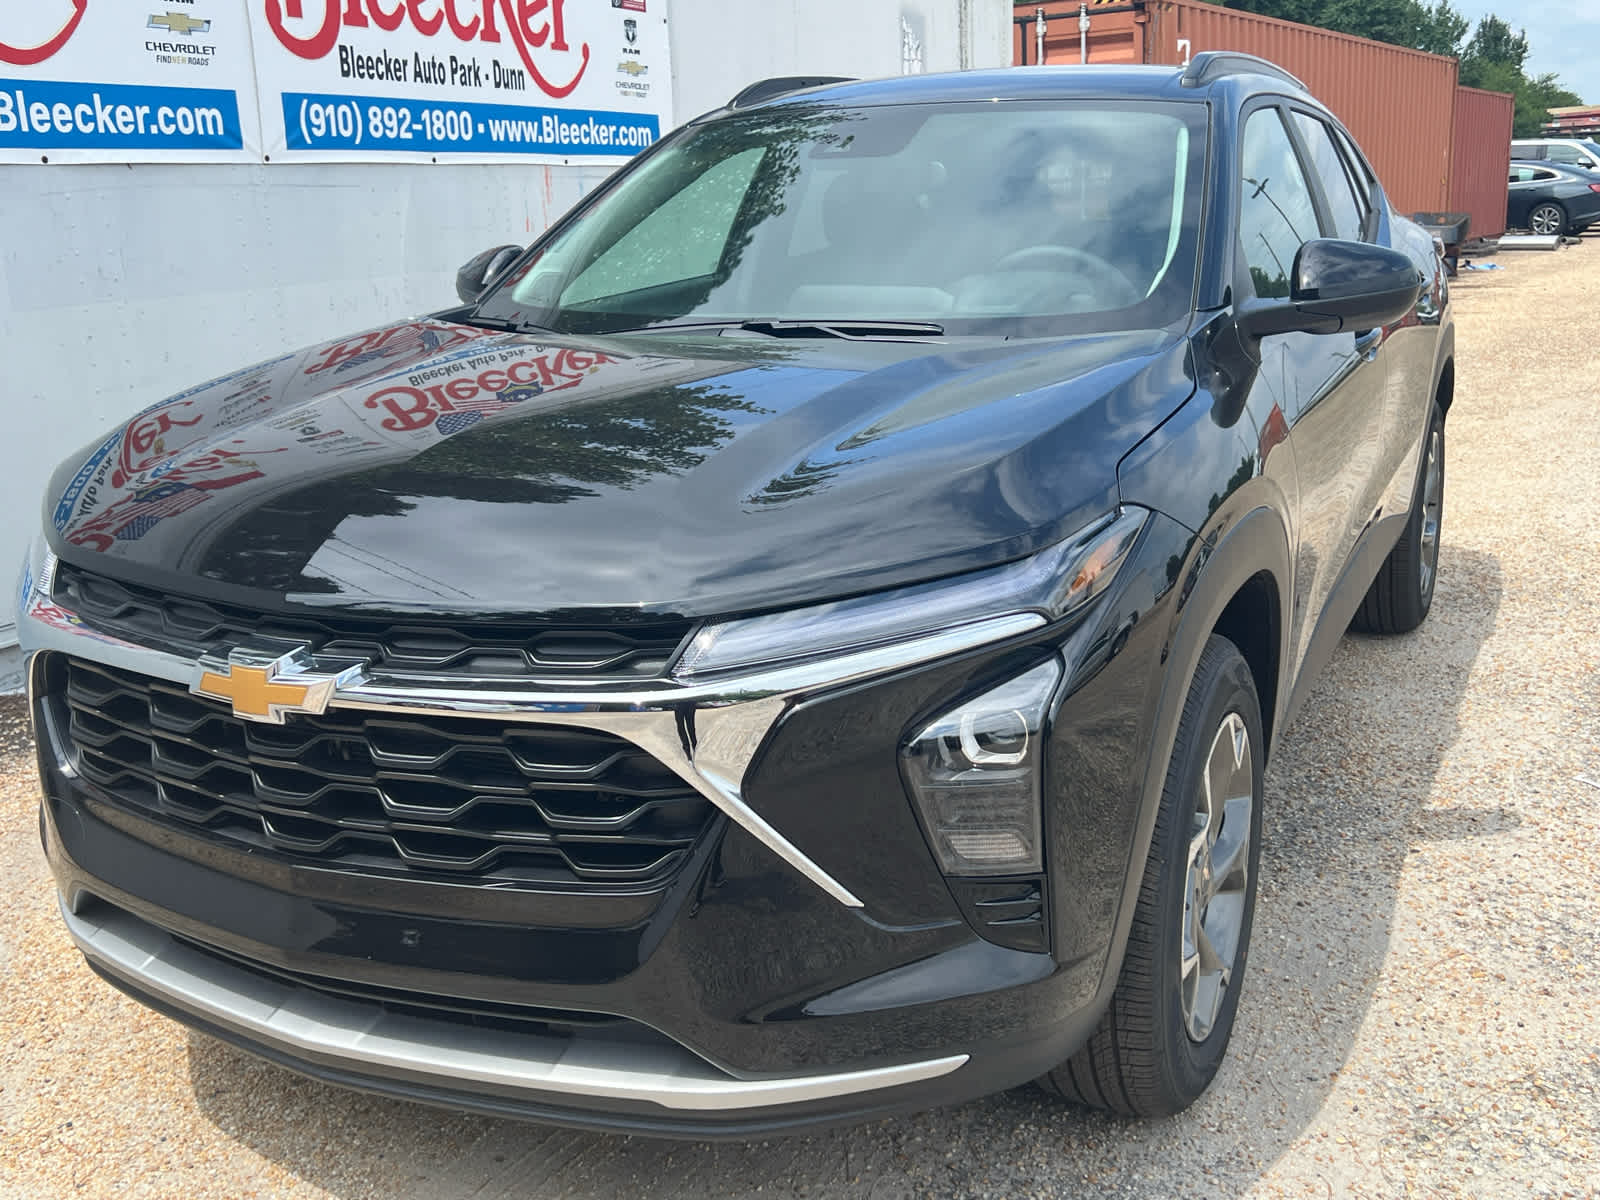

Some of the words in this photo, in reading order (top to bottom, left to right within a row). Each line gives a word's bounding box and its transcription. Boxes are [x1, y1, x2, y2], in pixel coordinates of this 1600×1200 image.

[145, 41, 216, 55] CHEVROLET
[338, 45, 408, 83] Bleecker
[413, 52, 446, 86] Auto
[449, 55, 482, 88] Park
[492, 59, 526, 91] Dunn
[299, 98, 363, 145] (910)
[368, 105, 473, 141] 892-1800
[488, 113, 651, 147] www.Bleecker.com
